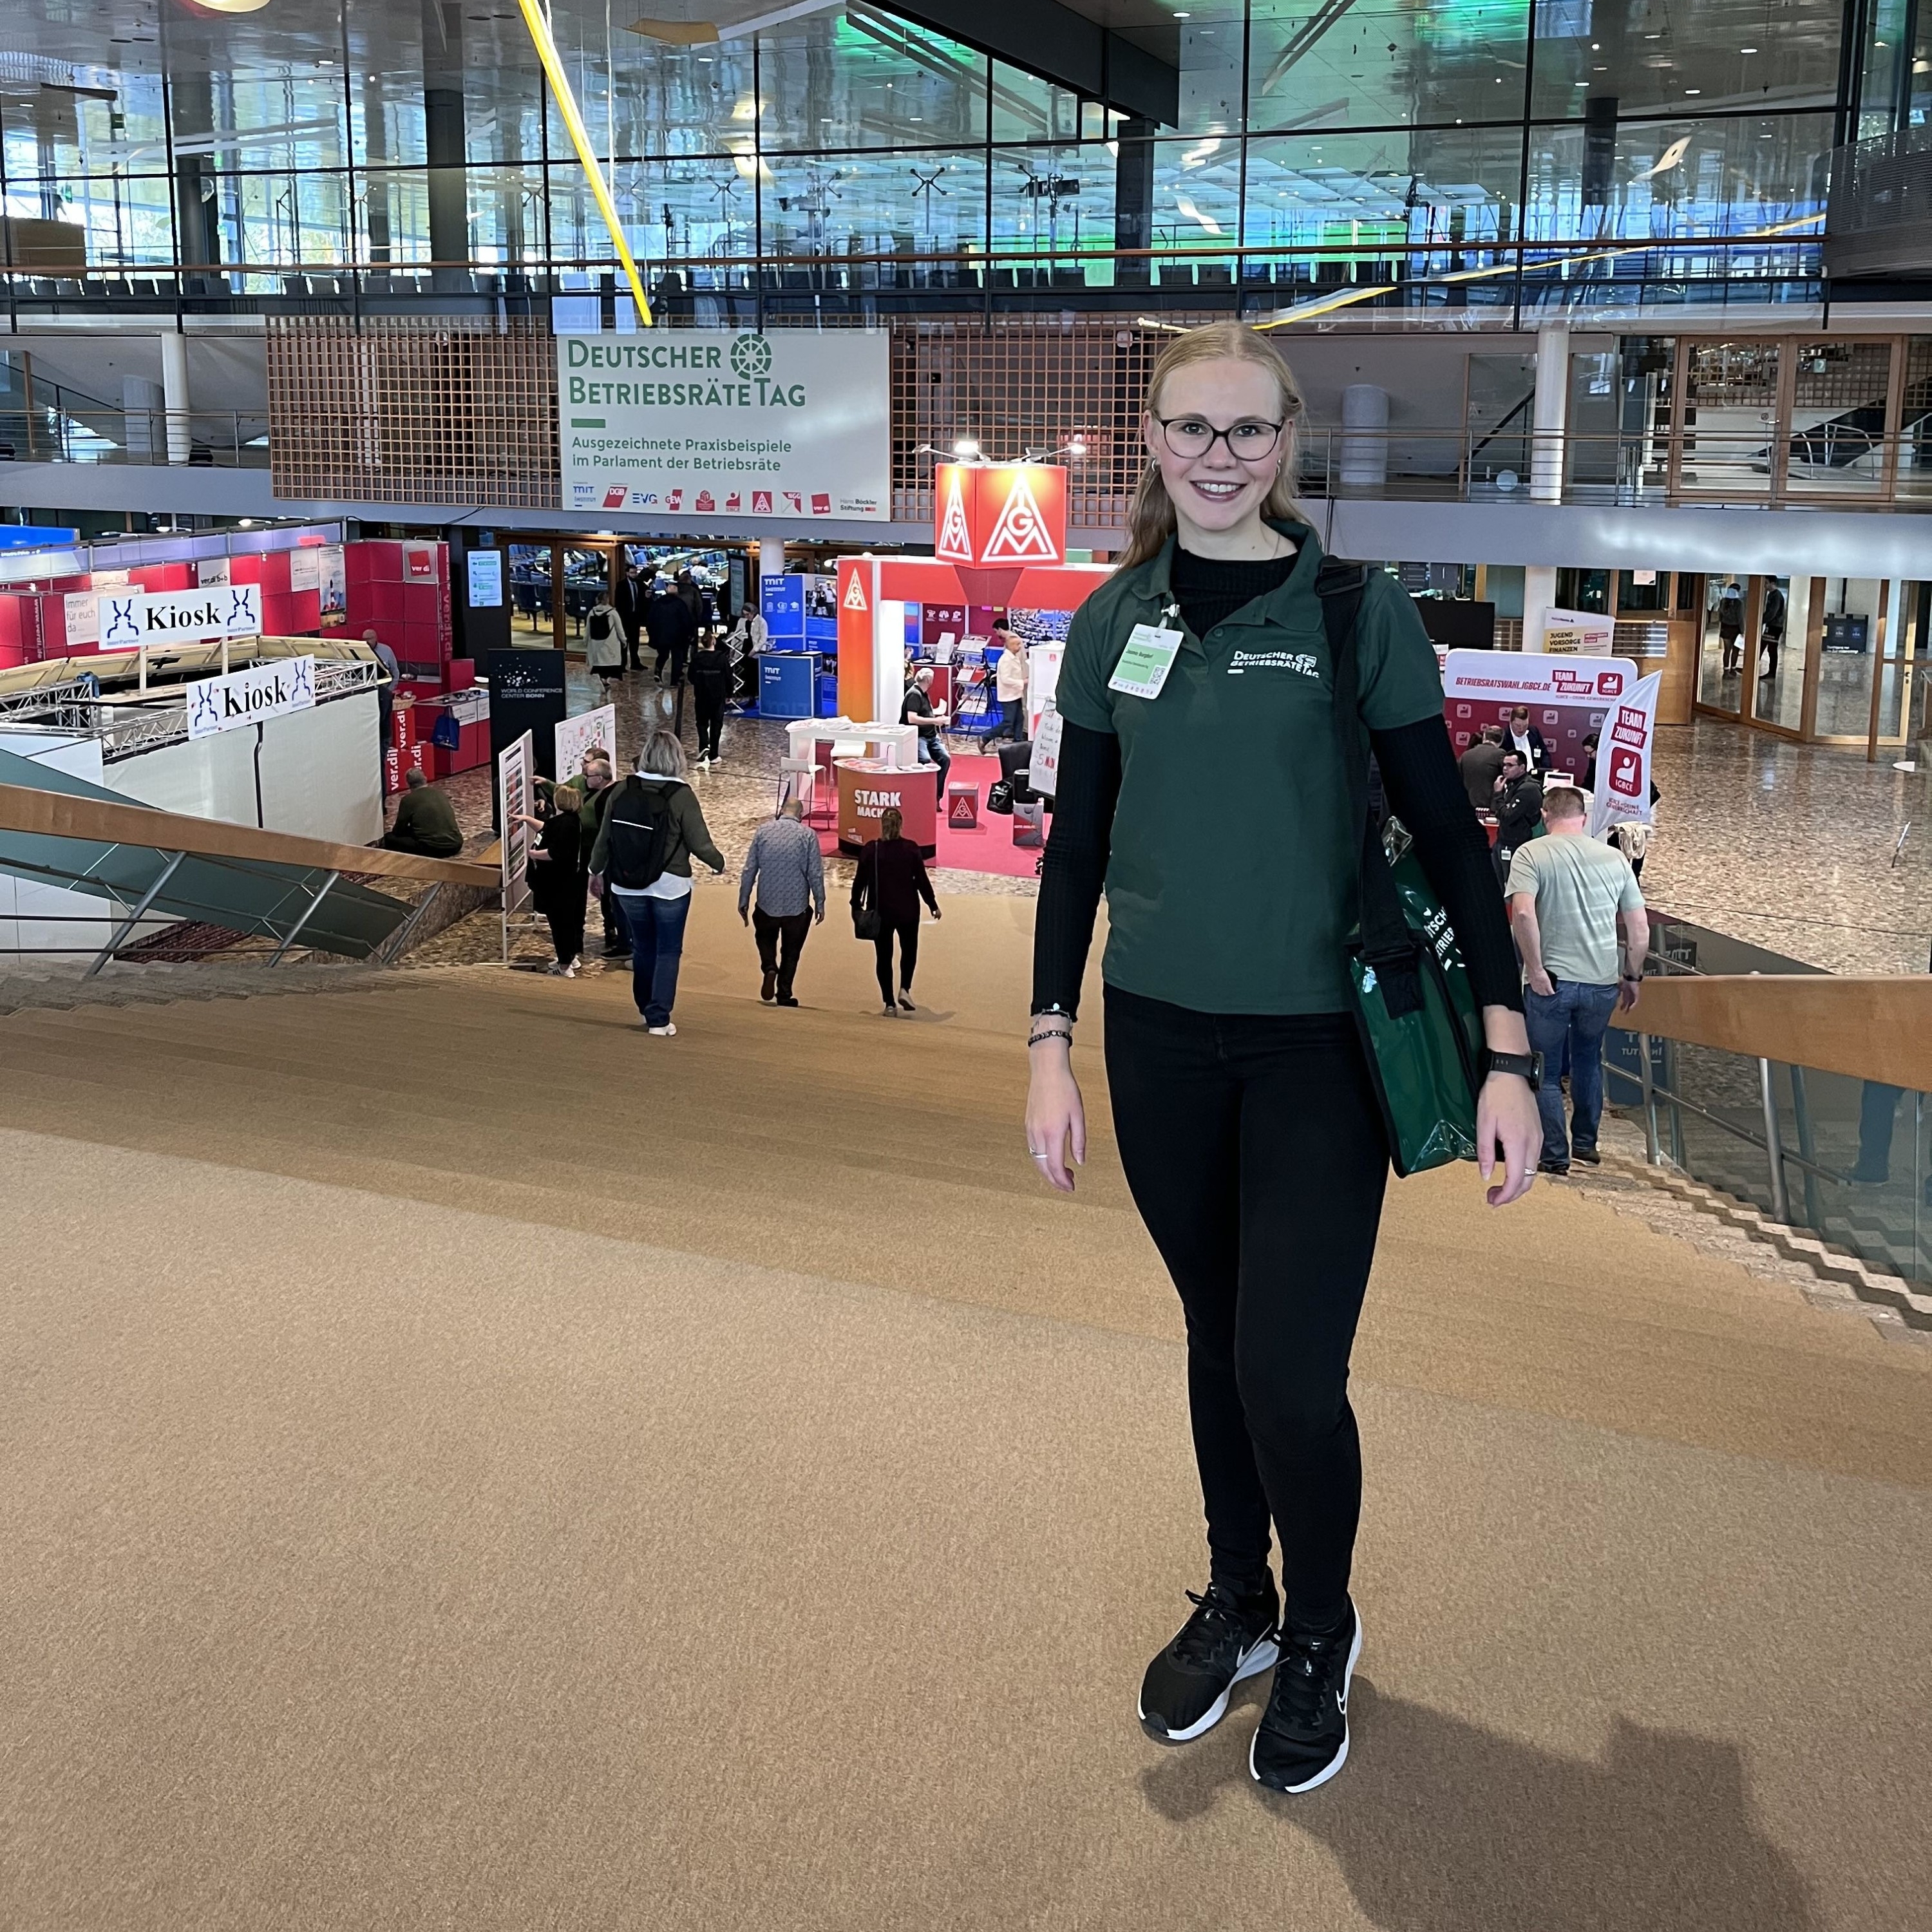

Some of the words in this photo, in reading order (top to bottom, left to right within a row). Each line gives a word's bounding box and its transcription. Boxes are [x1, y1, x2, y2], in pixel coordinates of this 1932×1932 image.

[568, 339, 721, 368] DEUTSCHER
[572, 437, 681, 451] Ausgezeichnete
[685, 439, 791, 453] Praxisbeispiele
[573, 456, 589, 467] im
[594, 456, 663, 469] Parlament
[667, 457, 689, 469] der
[694, 458, 781, 471] Betriebsräte
[632, 493, 658, 504] EVG
[665, 495, 683, 504] GEW
[66, 599, 89, 609] Immer
[66, 612, 77, 621] für
[79, 609, 95, 619] euch
[145, 602, 222, 631] Kiosk
[1233, 650, 1294, 661] DEUTSCHER
[1555, 671, 1574, 681] TEAM
[1455, 677, 1552, 691] BETRIEBSRATSWAHL.IGBCE.DE
[1559, 682, 1591, 693] ZUKUNFT
[222, 676, 288, 718] Kiosk
[1622, 709, 1643, 729] TEAM
[397, 710, 407, 748] ver.di
[1615, 726, 1643, 746] ZUKUNFT
[411, 745, 422, 770] r.di
[1615, 779, 1633, 792] IGBCE
[854, 789, 902, 807] STARK
[857, 806, 886, 819] MACH
